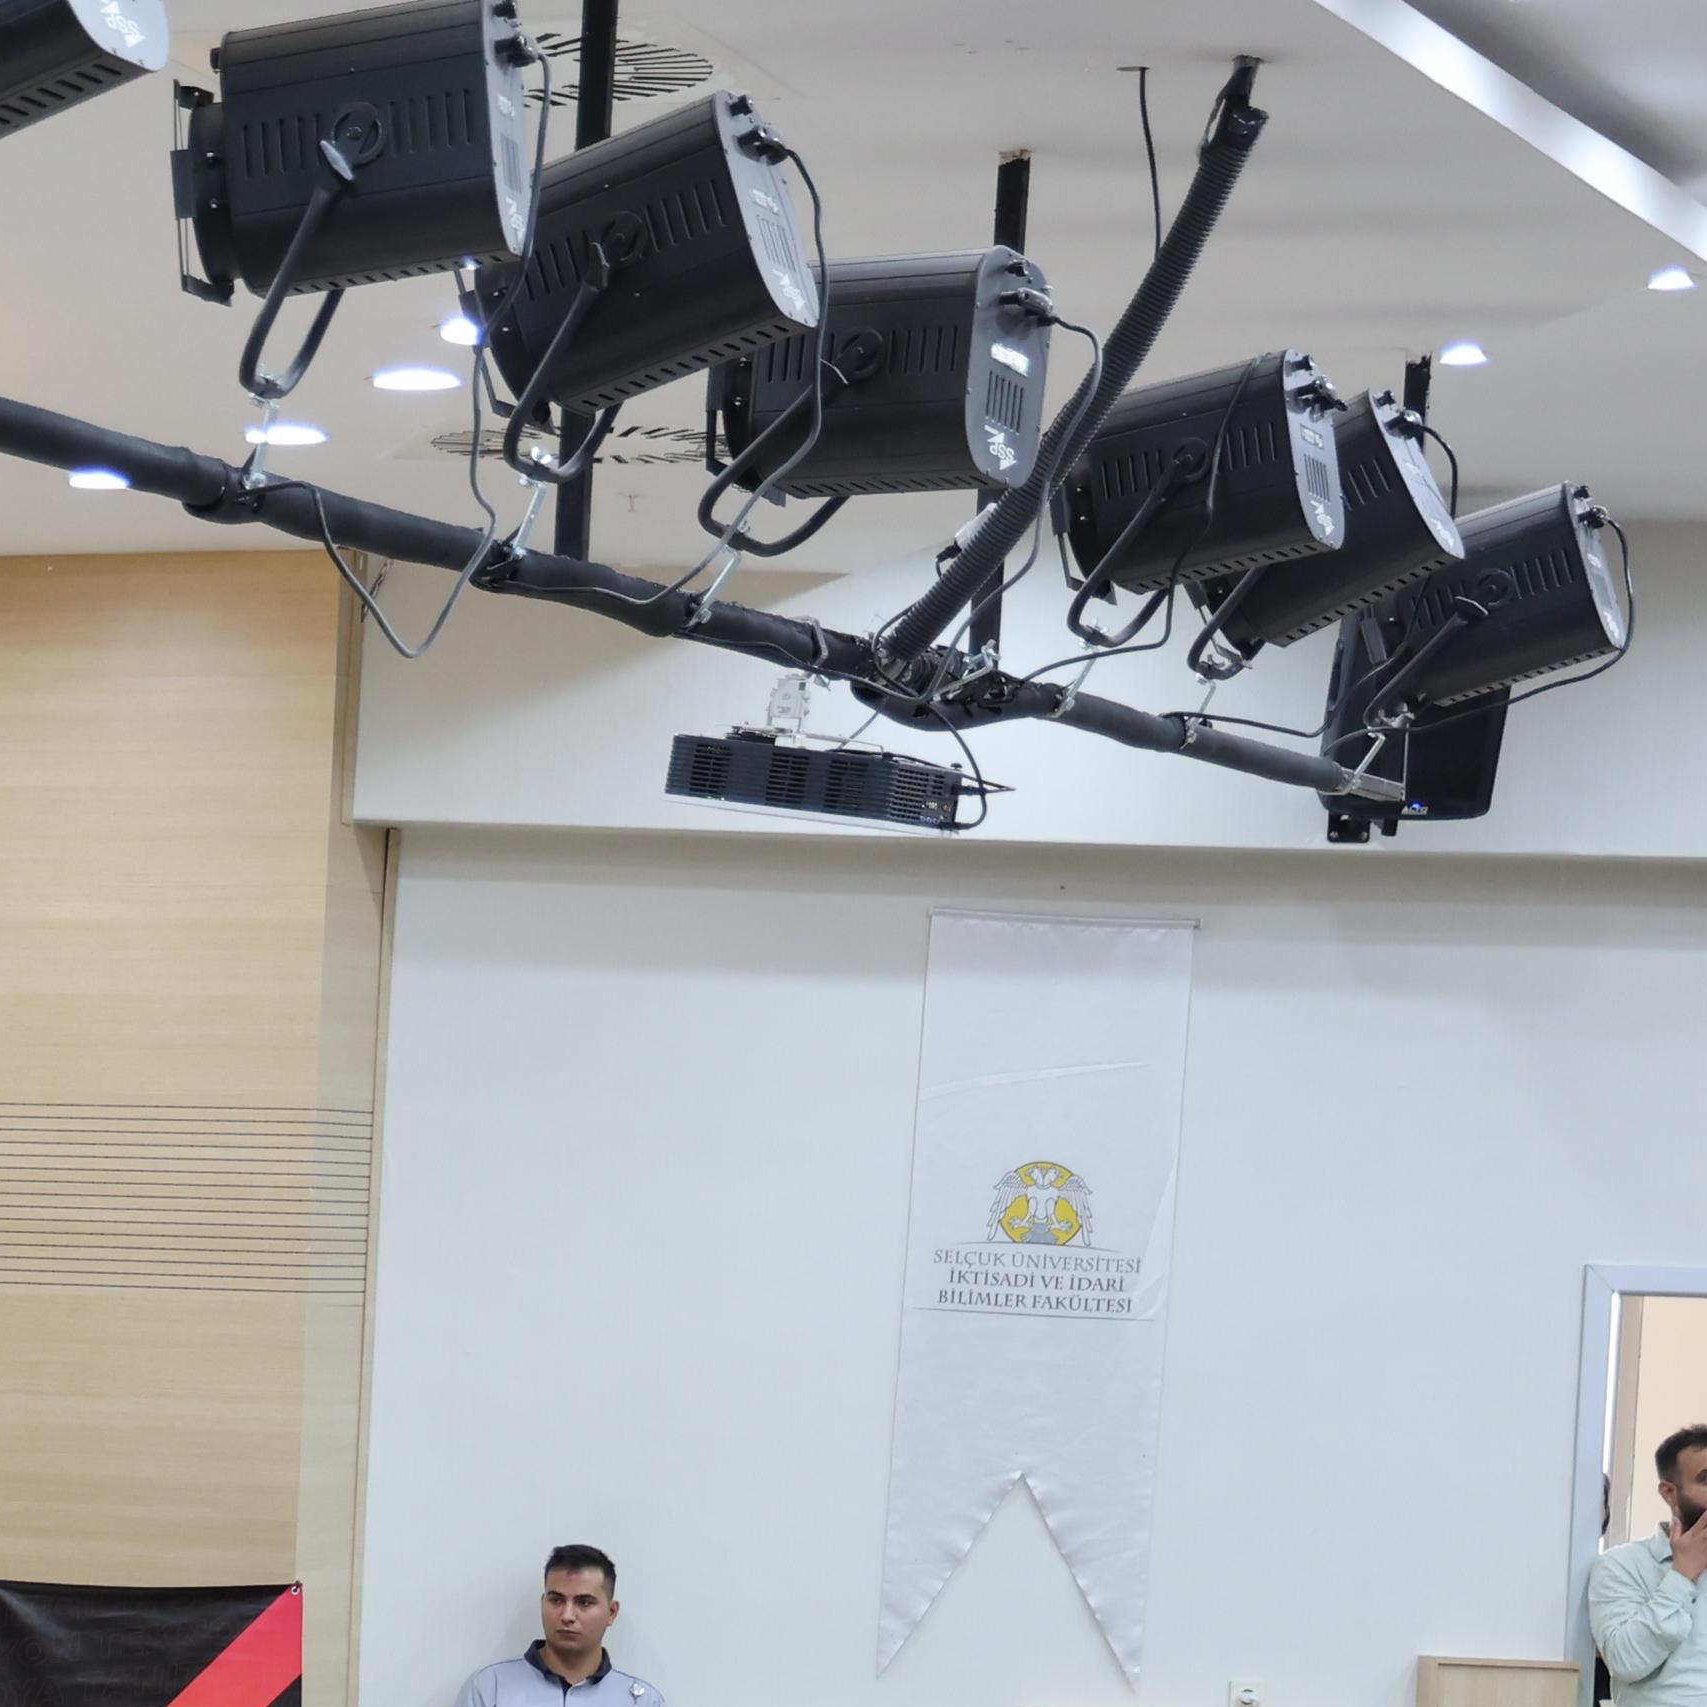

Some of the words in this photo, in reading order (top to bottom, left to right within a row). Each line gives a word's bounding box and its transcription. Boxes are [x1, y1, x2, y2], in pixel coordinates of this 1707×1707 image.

[933, 1249, 1006, 1270] SELÇUK
[1011, 1250, 1142, 1274] ÜNİVERSİTESİ
[948, 1266, 1036, 1289] İKTİSADİ
[1040, 1275, 1064, 1290] VE
[1069, 1275, 1125, 1293] İDARİ
[937, 1288, 1027, 1309] BİLİMLER
[1031, 1295, 1133, 1314] FAKÜLTESİ
